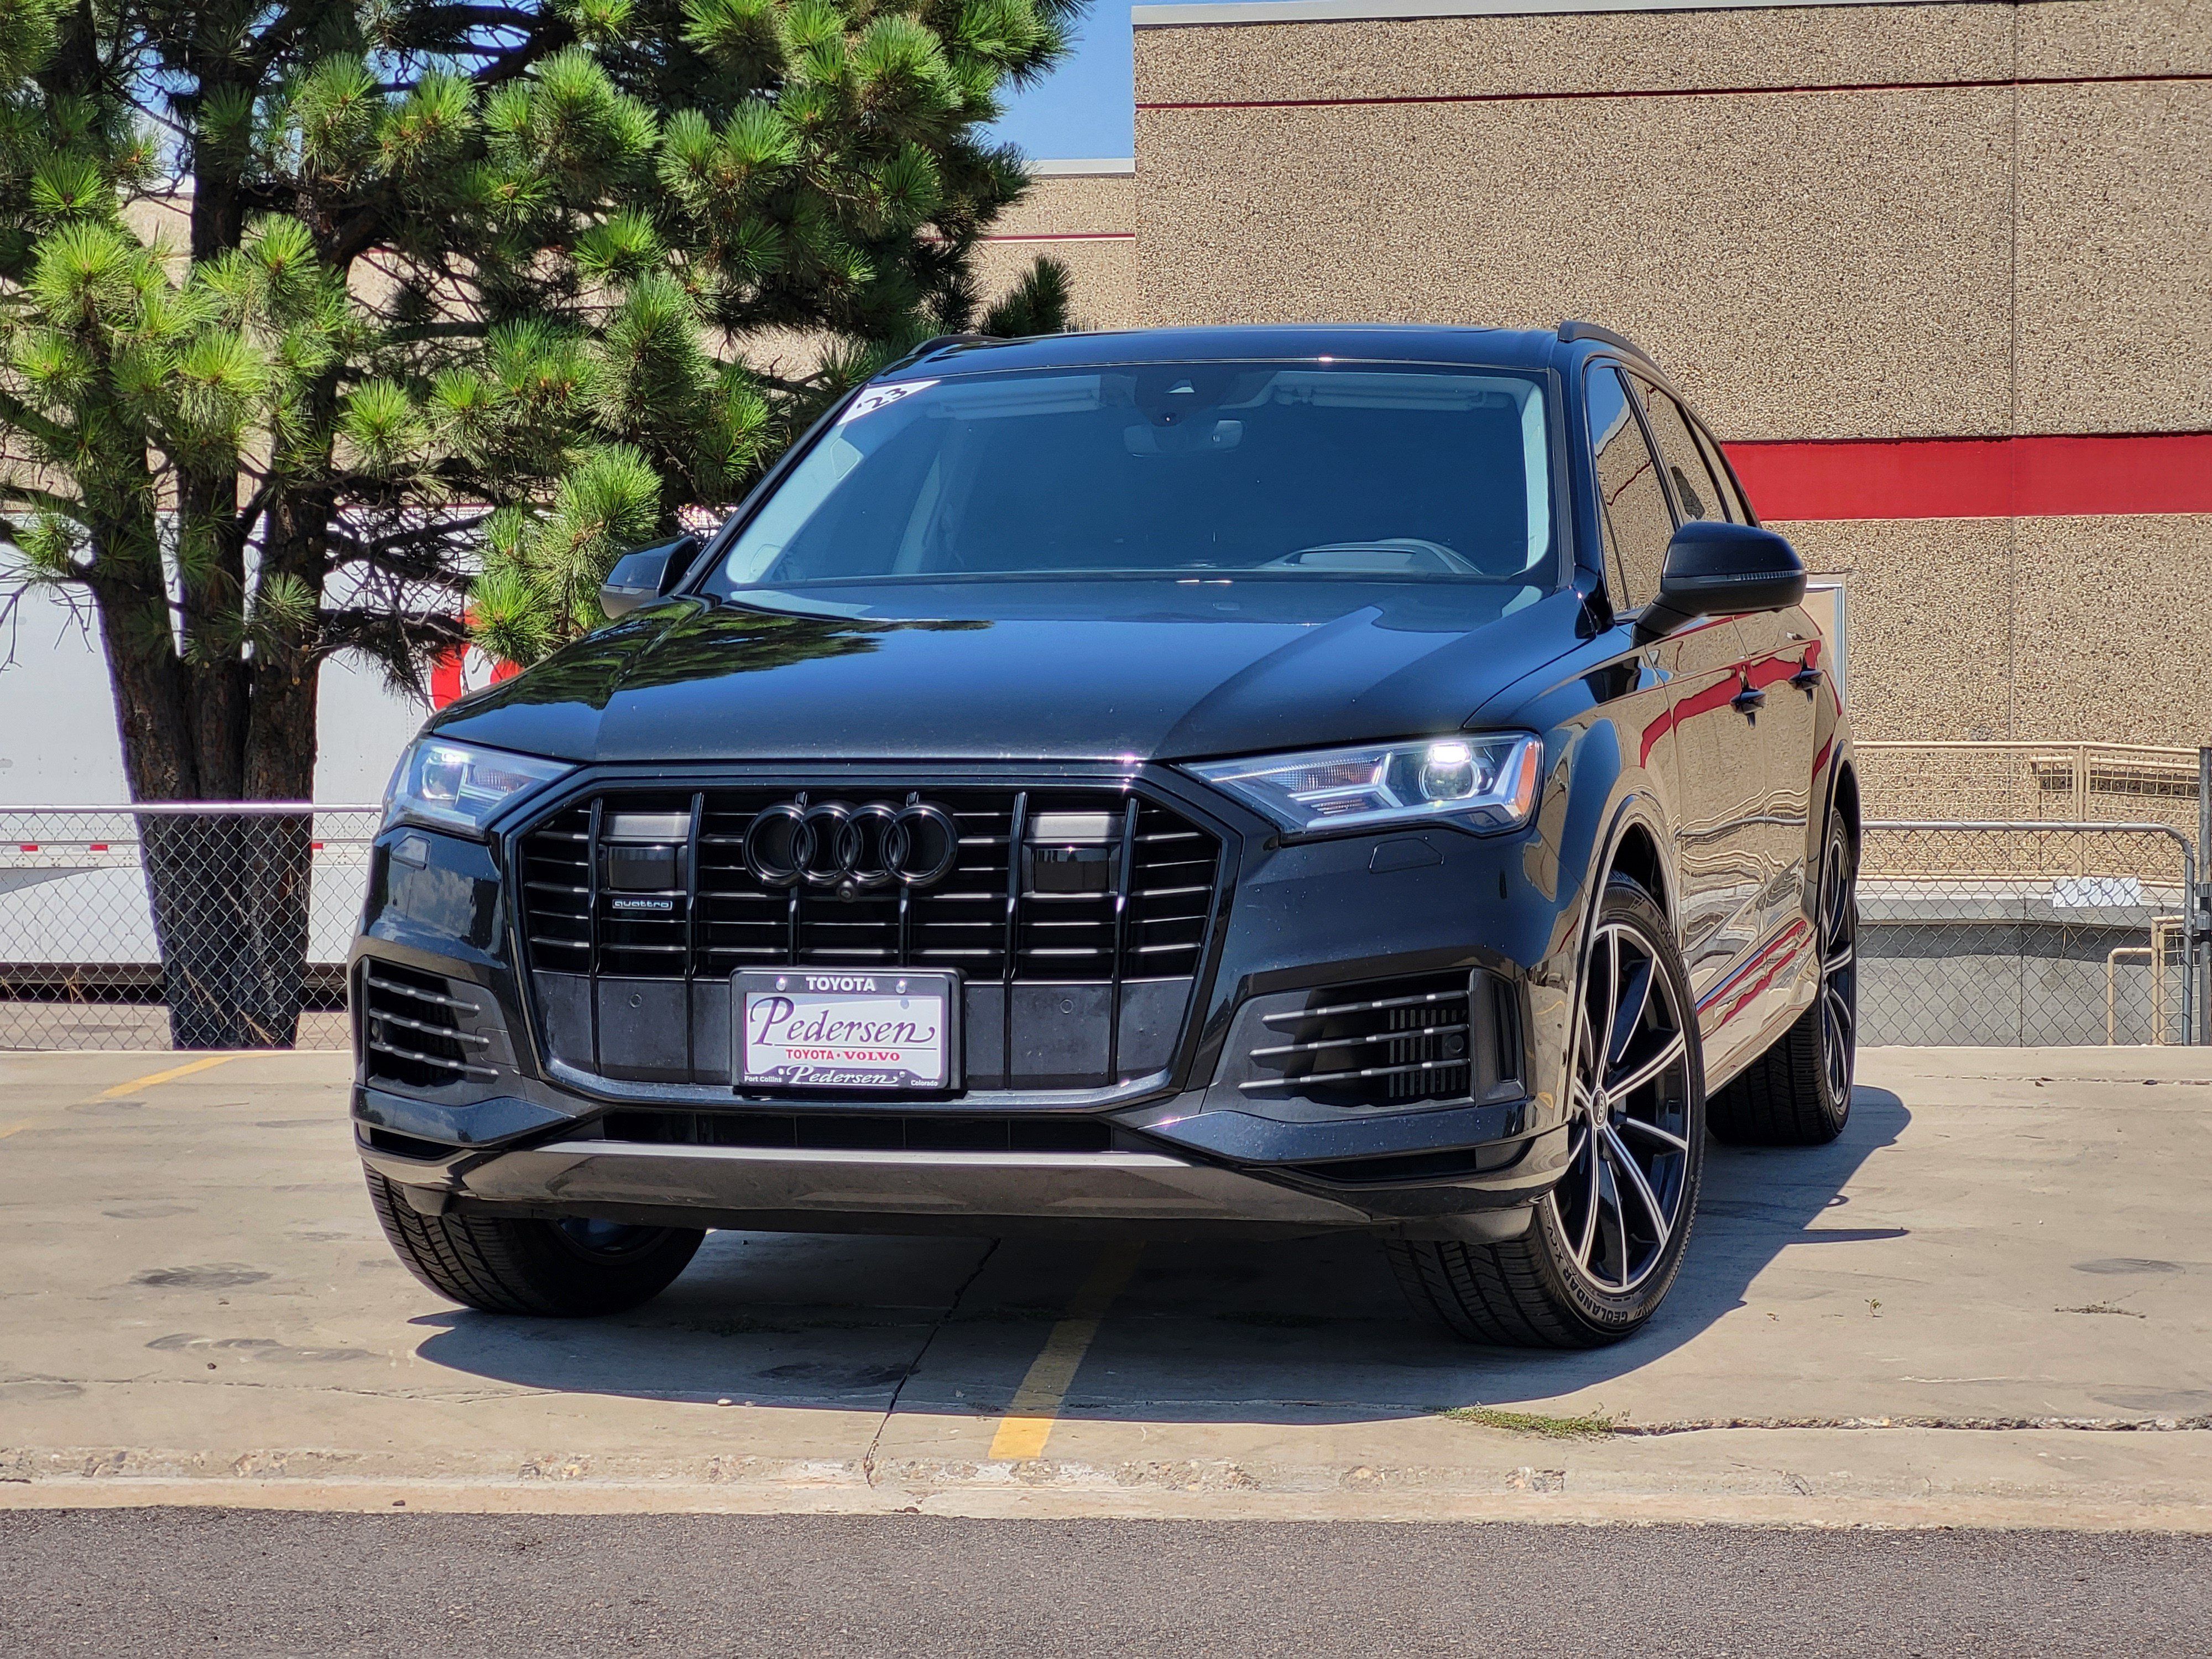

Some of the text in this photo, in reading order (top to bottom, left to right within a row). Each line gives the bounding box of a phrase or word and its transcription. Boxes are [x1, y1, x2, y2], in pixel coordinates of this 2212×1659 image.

[805, 977, 876, 992] TOYOTA
[750, 996, 935, 1046] Pedersen
[785, 1049, 900, 1061] TOYOTA VOLVO
[786, 1063, 898, 1084] Pedersen
[910, 1079, 938, 1087] Colorado
[1562, 1266, 1629, 1323] GEOLANDAR
